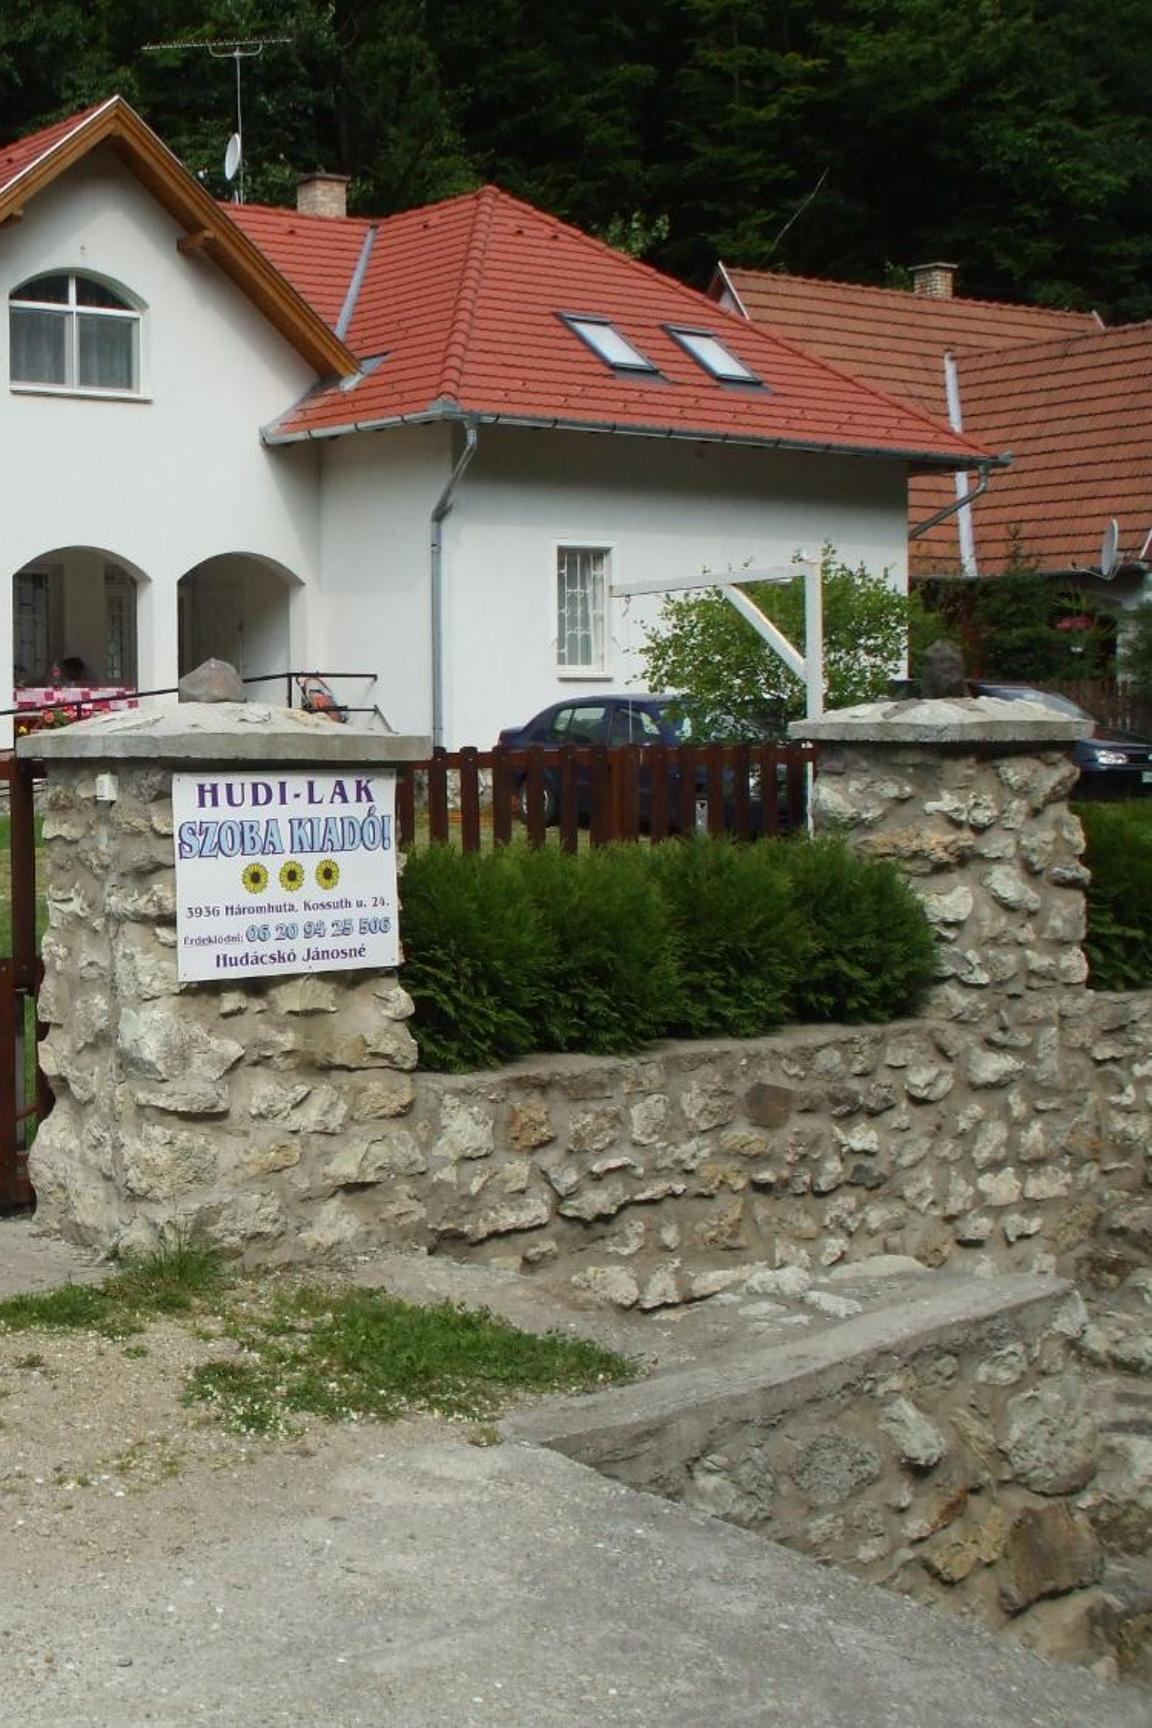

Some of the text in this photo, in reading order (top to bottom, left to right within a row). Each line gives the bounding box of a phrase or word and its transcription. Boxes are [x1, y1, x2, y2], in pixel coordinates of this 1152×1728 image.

[197, 777, 375, 808] HUDI-LAK
[179, 805, 391, 860] SZOBA KIADÓ!
[186, 905, 220, 919] 3936
[303, 896, 352, 912] Kossuth
[356, 898, 367, 909] u.
[372, 896, 390, 908] 24.
[245, 924, 271, 943] 06
[274, 922, 299, 941] 20
[304, 920, 326, 939] 94
[331, 918, 354, 937] 25
[215, 944, 367, 969] Hudácskó Jánosné
